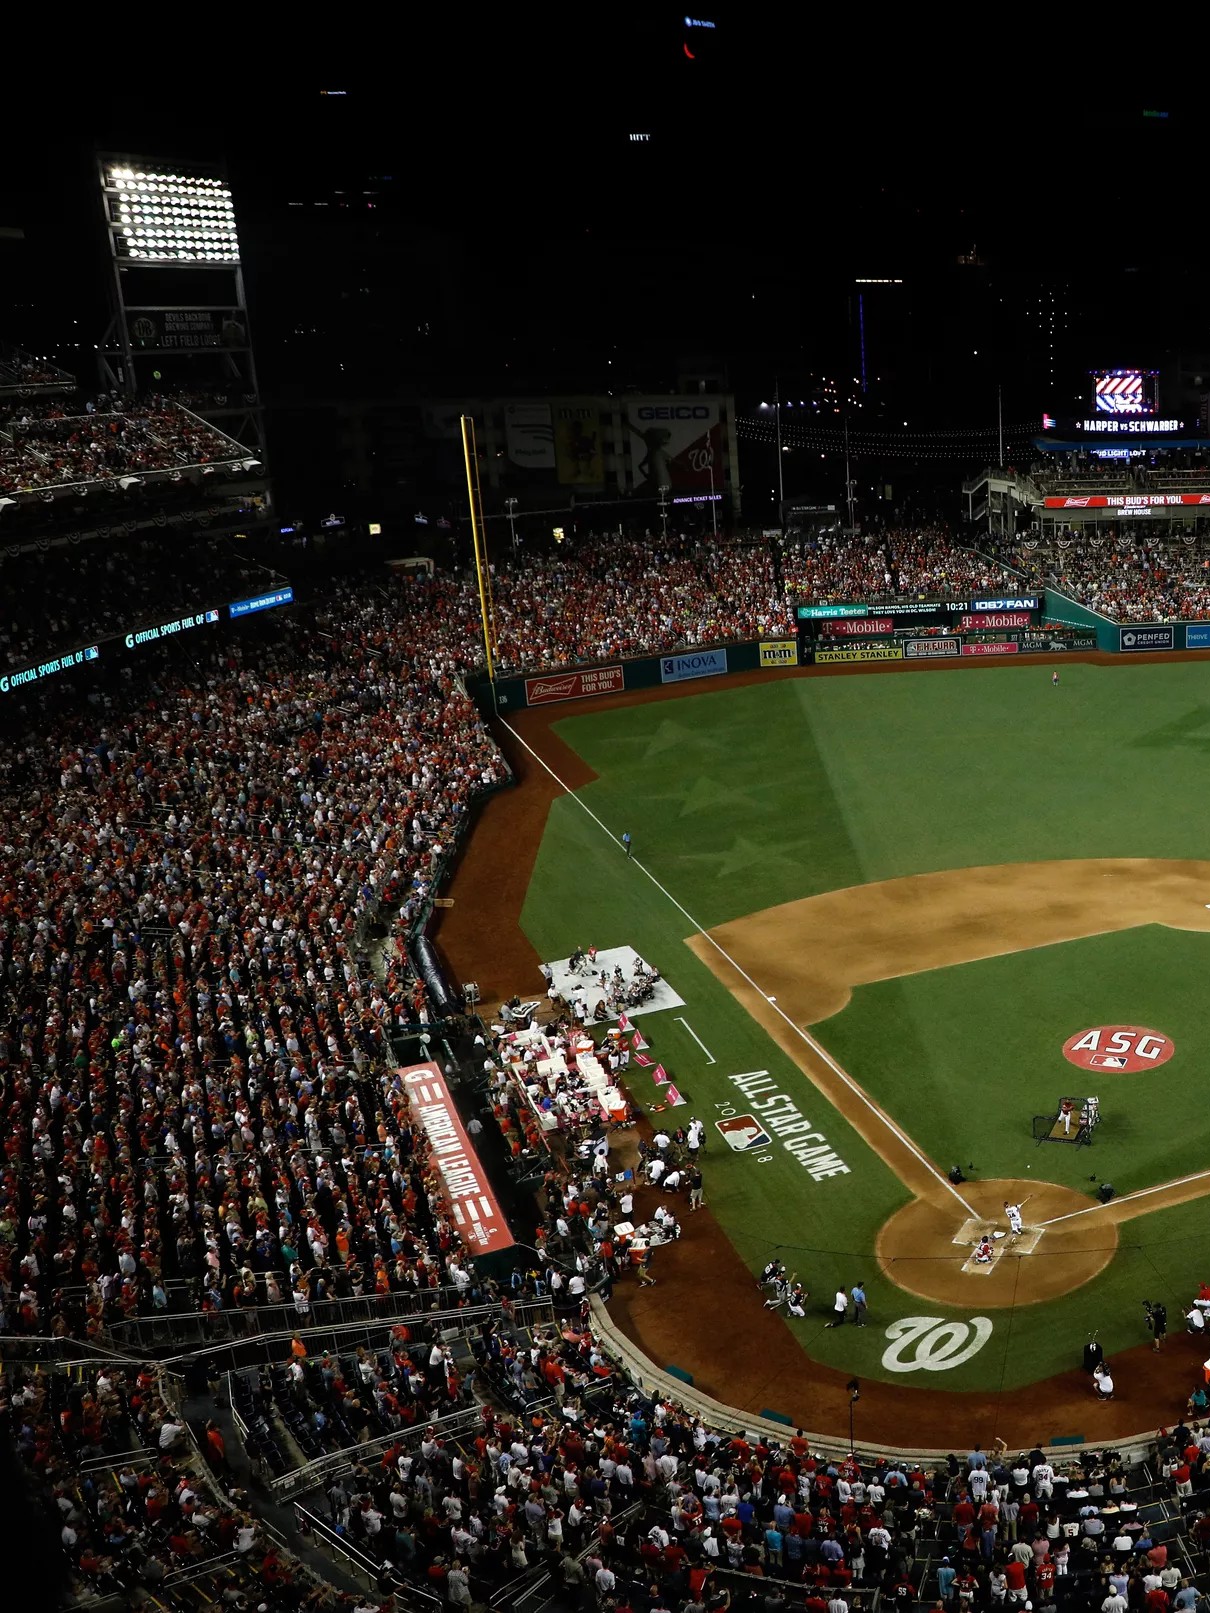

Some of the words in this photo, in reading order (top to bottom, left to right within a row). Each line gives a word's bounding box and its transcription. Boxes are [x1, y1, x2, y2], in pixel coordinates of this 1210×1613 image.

[638, 407, 709, 420] GEICO
[1084, 420, 1118, 431] HARPER
[1129, 420, 1178, 431] SCHWARBER
[1107, 497, 1124, 505] THIS
[1126, 496, 1148, 505] BUD'S
[1150, 496, 1165, 505] FOR
[1166, 495, 1184, 504] YOU.
[946, 603, 968, 611] 10:21
[1007, 599, 1034, 608] FAN
[811, 607, 838, 616] Harris
[840, 606, 865, 615] Teeter
[125, 633, 134, 648] G
[135, 628, 160, 644] OFFICIAL
[160, 621, 181, 636] SPORTS
[182, 617, 195, 629] FUEL
[196, 614, 204, 625] OF
[1137, 633, 1170, 641] PENFED
[1073, 639, 1093, 647] MGM
[818, 652, 857, 661] STANLEY
[861, 650, 899, 660] STANLEY
[11, 669, 38, 688] OFFICIAL
[39, 662, 60, 678] SPORTS
[61, 656, 75, 669] FUEL
[76, 652, 83, 663] OF
[677, 656, 717, 670] INOVA
[581, 673, 598, 683] THIS
[599, 669, 621, 681] BUD'S
[582, 683, 596, 693] FOR
[597, 680, 615, 691] YOU.
[1071, 1030, 1166, 1060] ASG
[728, 1070, 779, 1099] ALL
[714, 1101, 736, 1116] 20
[750, 1094, 812, 1137] STAR
[418, 1103, 465, 1156] AMERICAN
[751, 1149, 773, 1163] 18
[783, 1133, 852, 1182] GAME
[437, 1153, 481, 1200] LEAGUE
[881, 1316, 993, 1372] W
